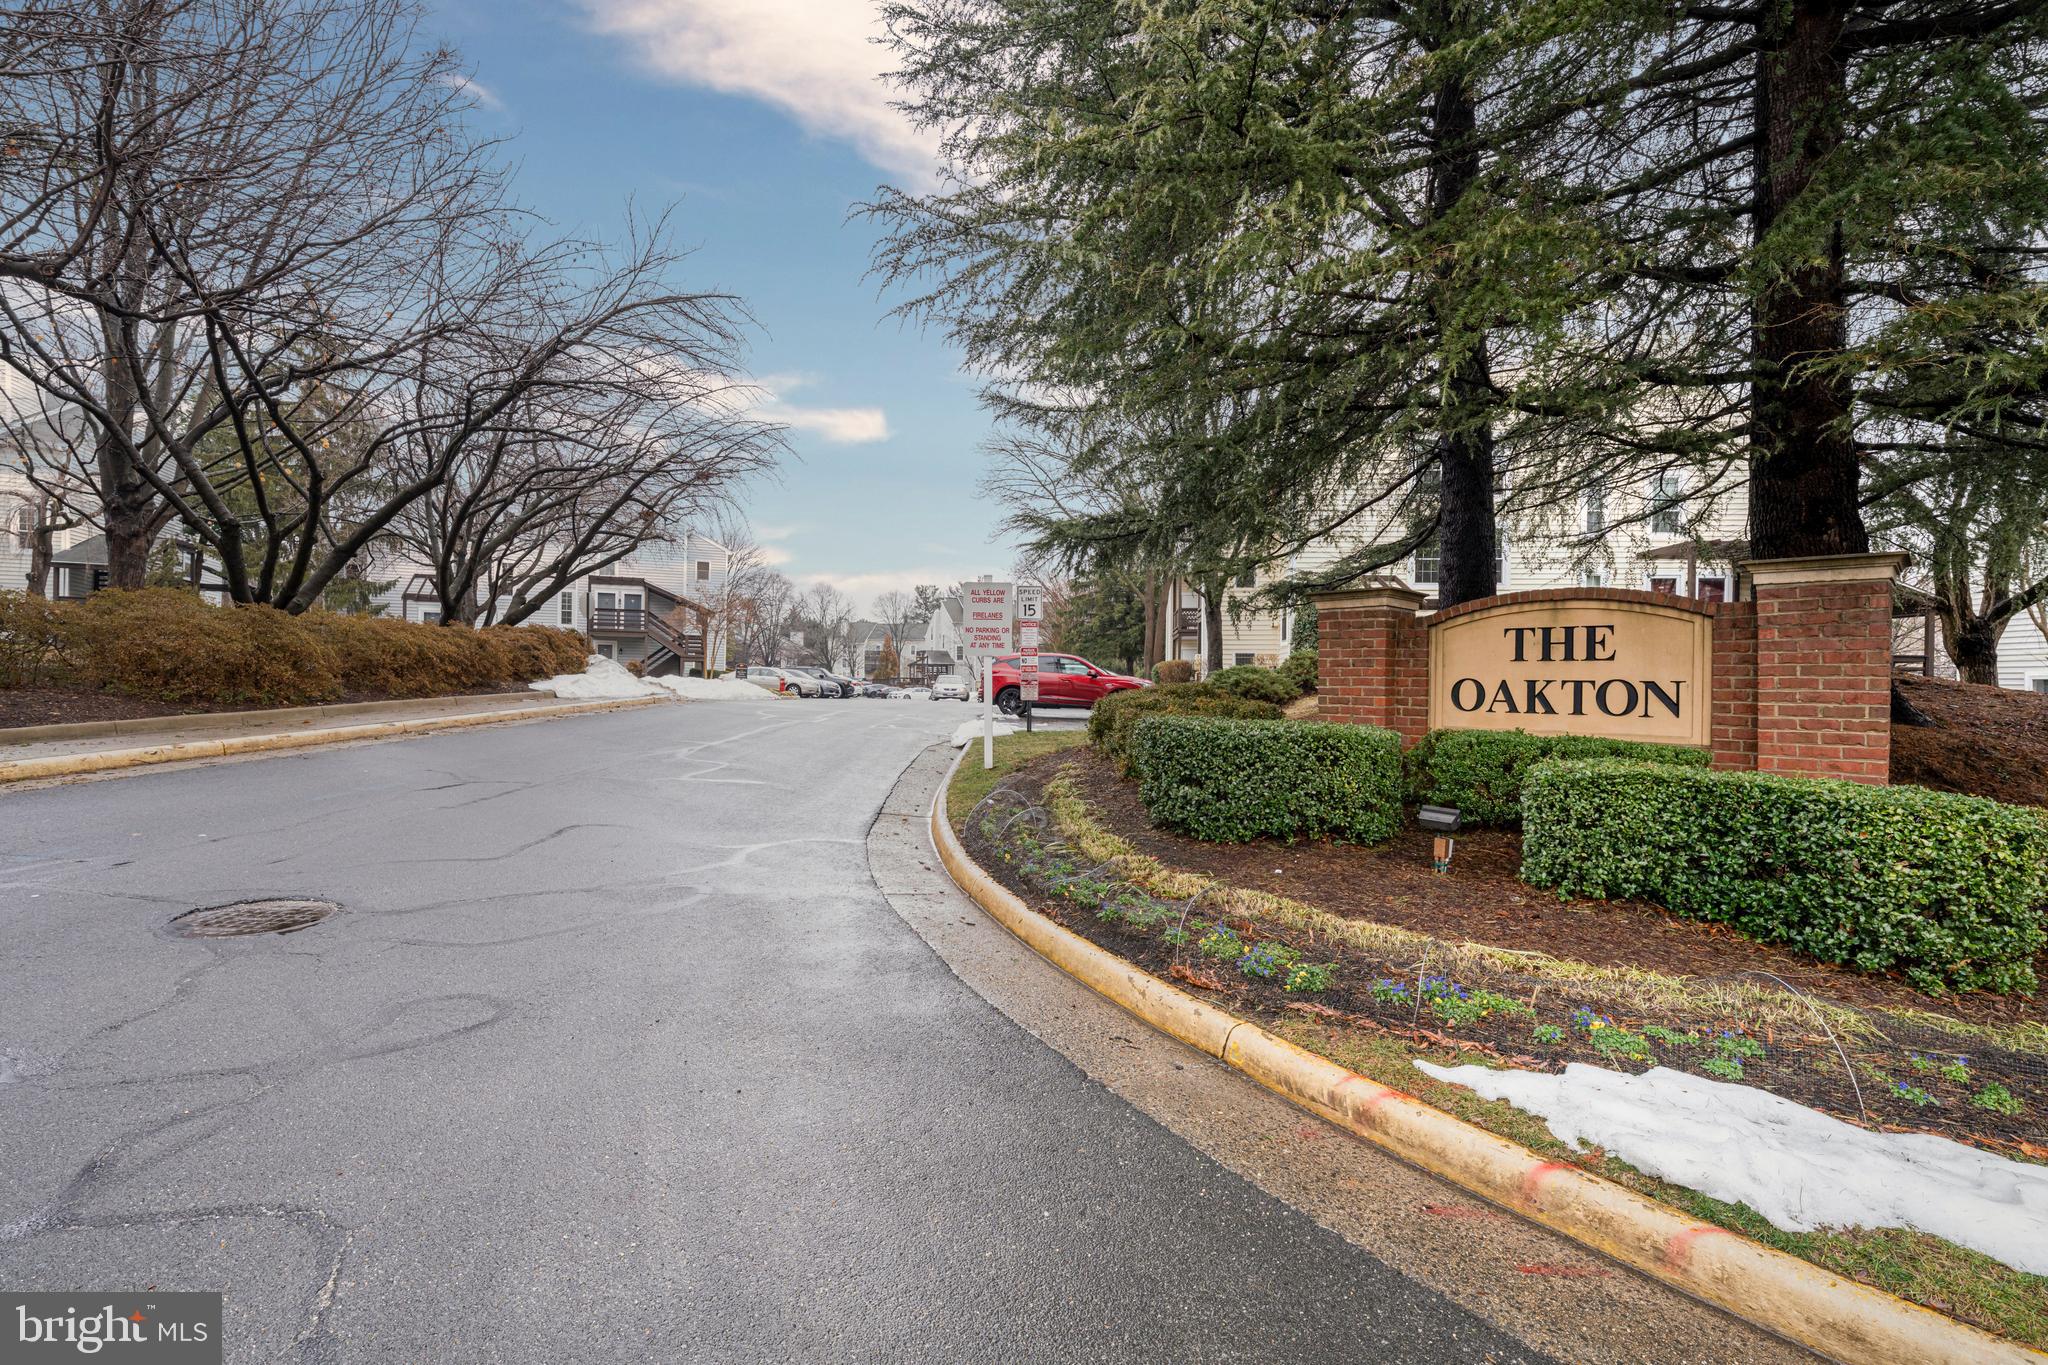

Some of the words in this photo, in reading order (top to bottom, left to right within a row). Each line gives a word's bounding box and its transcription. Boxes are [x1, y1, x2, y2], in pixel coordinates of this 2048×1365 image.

[1023, 604, 1036, 617] 15
[1503, 624, 1617, 662] THE
[1450, 677, 1687, 719] OAKTON
